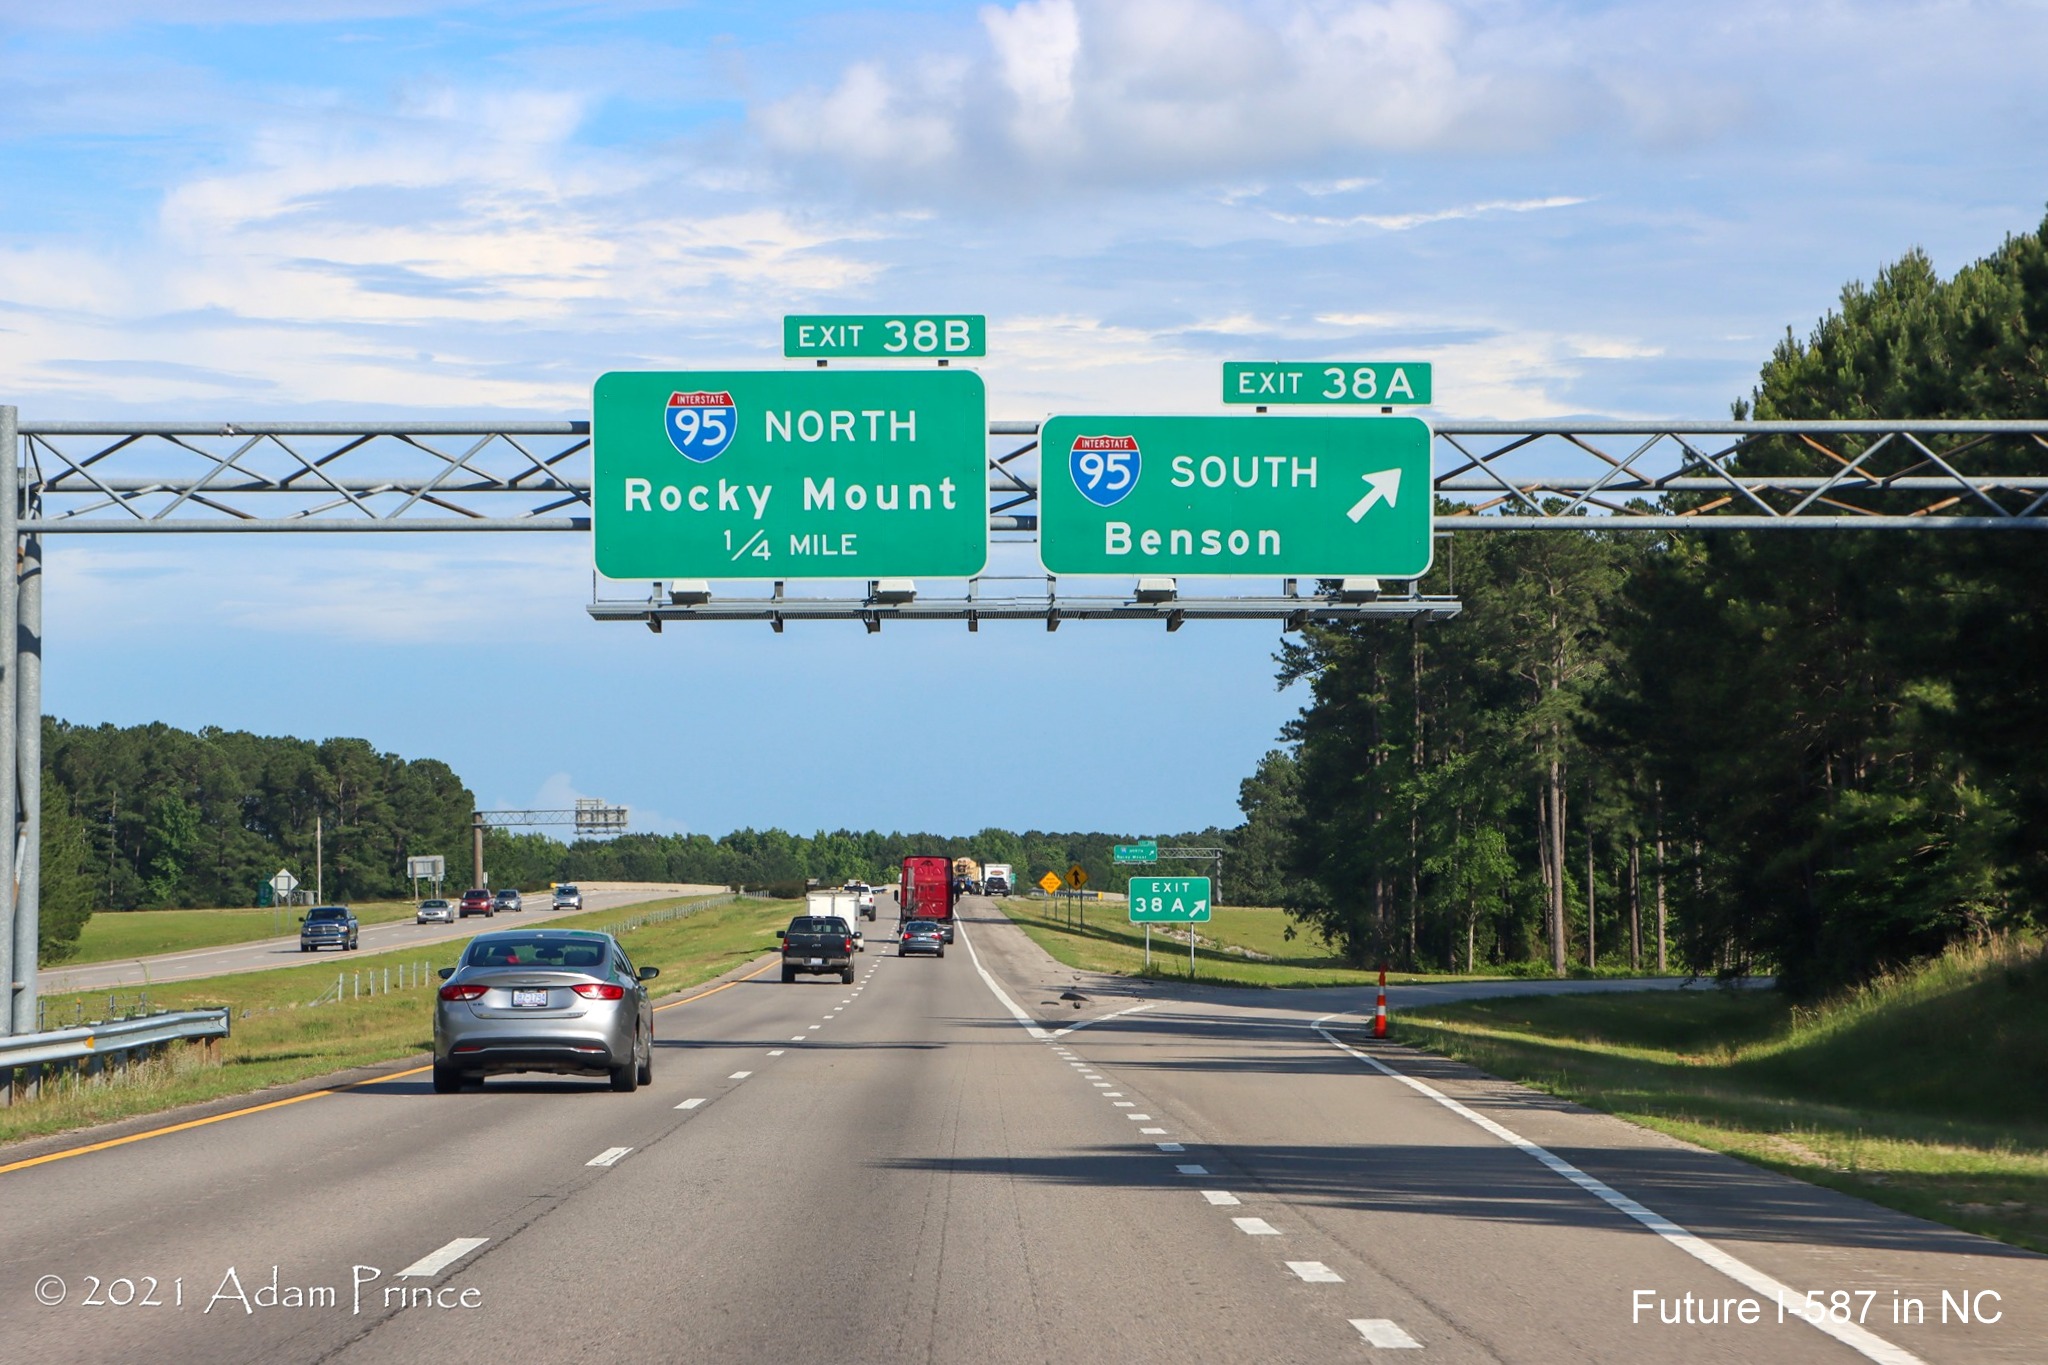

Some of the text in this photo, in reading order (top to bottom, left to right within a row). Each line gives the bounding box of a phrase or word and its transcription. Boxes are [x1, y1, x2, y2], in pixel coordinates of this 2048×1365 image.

[799, 320, 971, 352] EXIT 38B
[1239, 367, 1414, 399] EXIT 38A
[677, 395, 724, 405] INTERSTATE
[675, 408, 917, 446] 95 NORTH
[1081, 438, 1128, 448] INTERSTATE
[1080, 453, 1317, 490] 95 SOUTH
[625, 476, 956, 520] Rocky Mount
[724, 528, 858, 561] 1/4 MILE
[1105, 521, 1281, 555] Benson
[1152, 882, 1190, 893] EXIT
